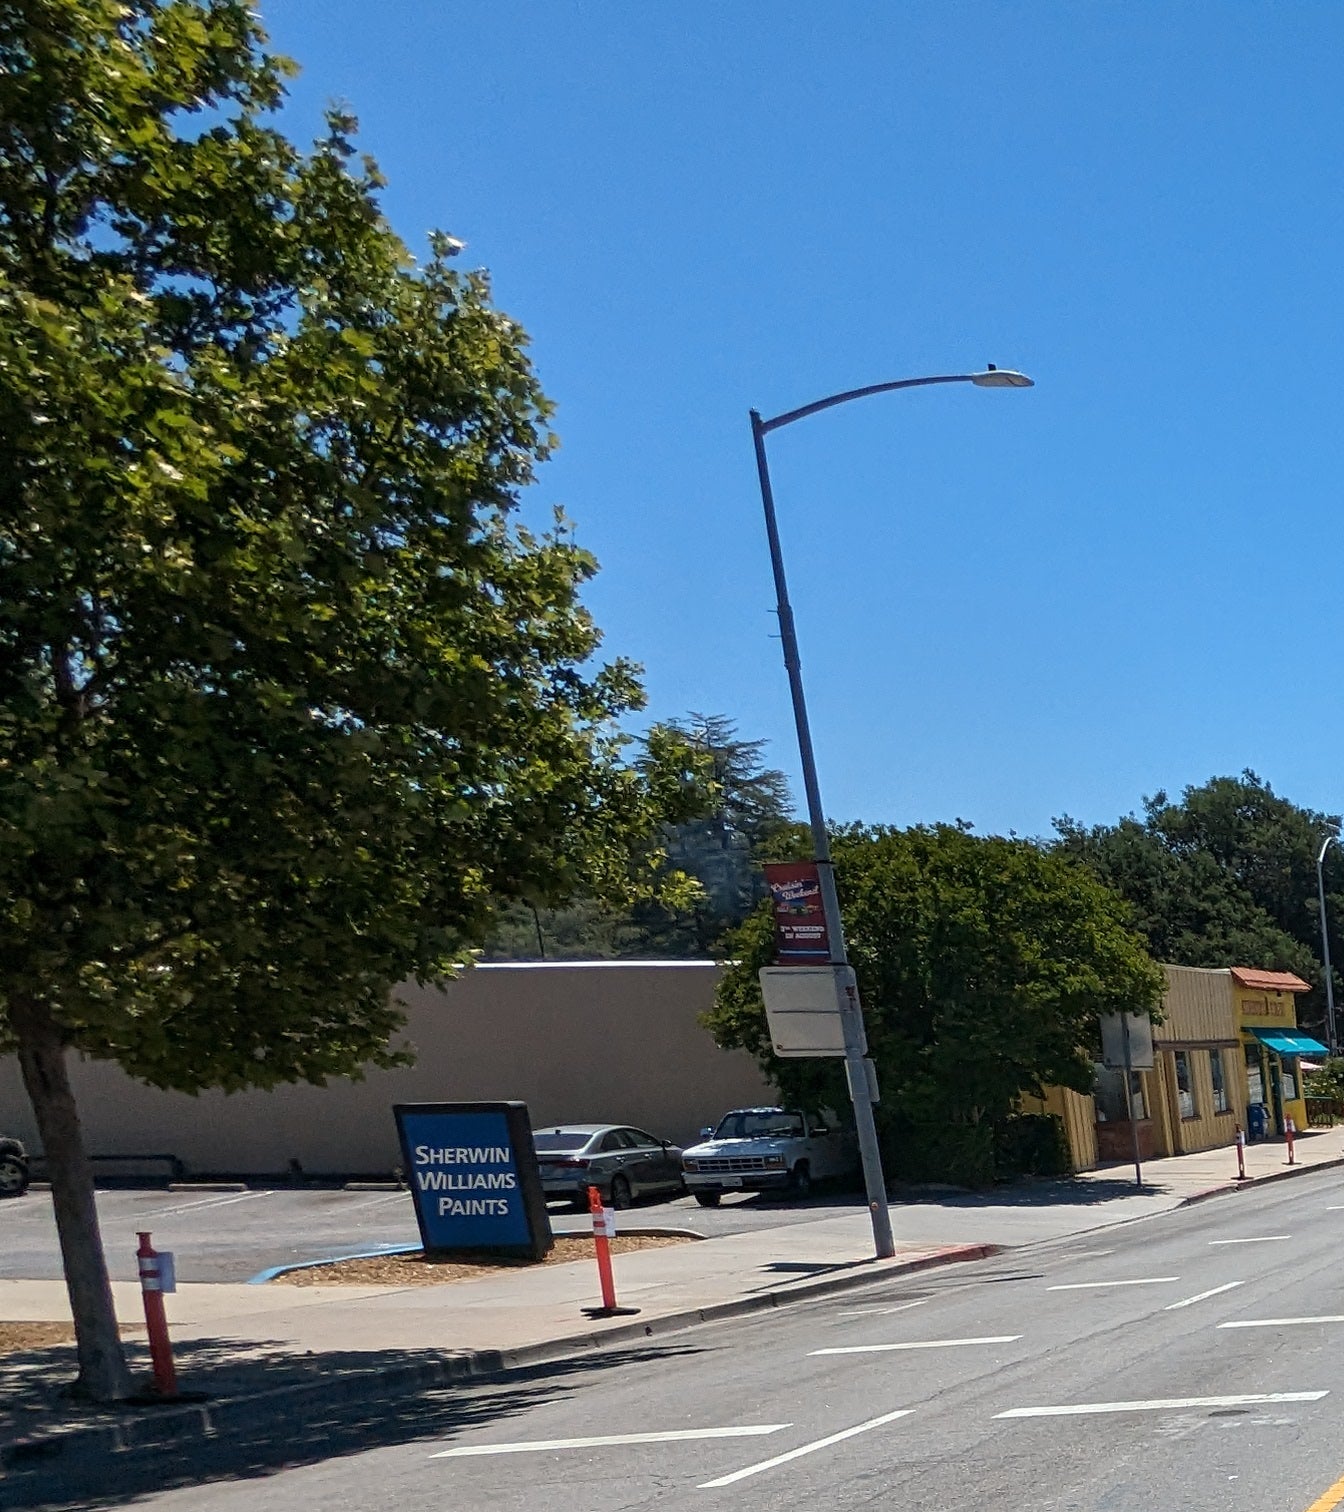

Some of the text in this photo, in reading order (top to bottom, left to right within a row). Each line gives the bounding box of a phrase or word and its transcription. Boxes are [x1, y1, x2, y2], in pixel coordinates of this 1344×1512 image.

[415, 1145, 510, 1165] SHERWIN
[416, 1171, 516, 1191] WILLIAMS
[438, 1197, 509, 1216] PAINTS
